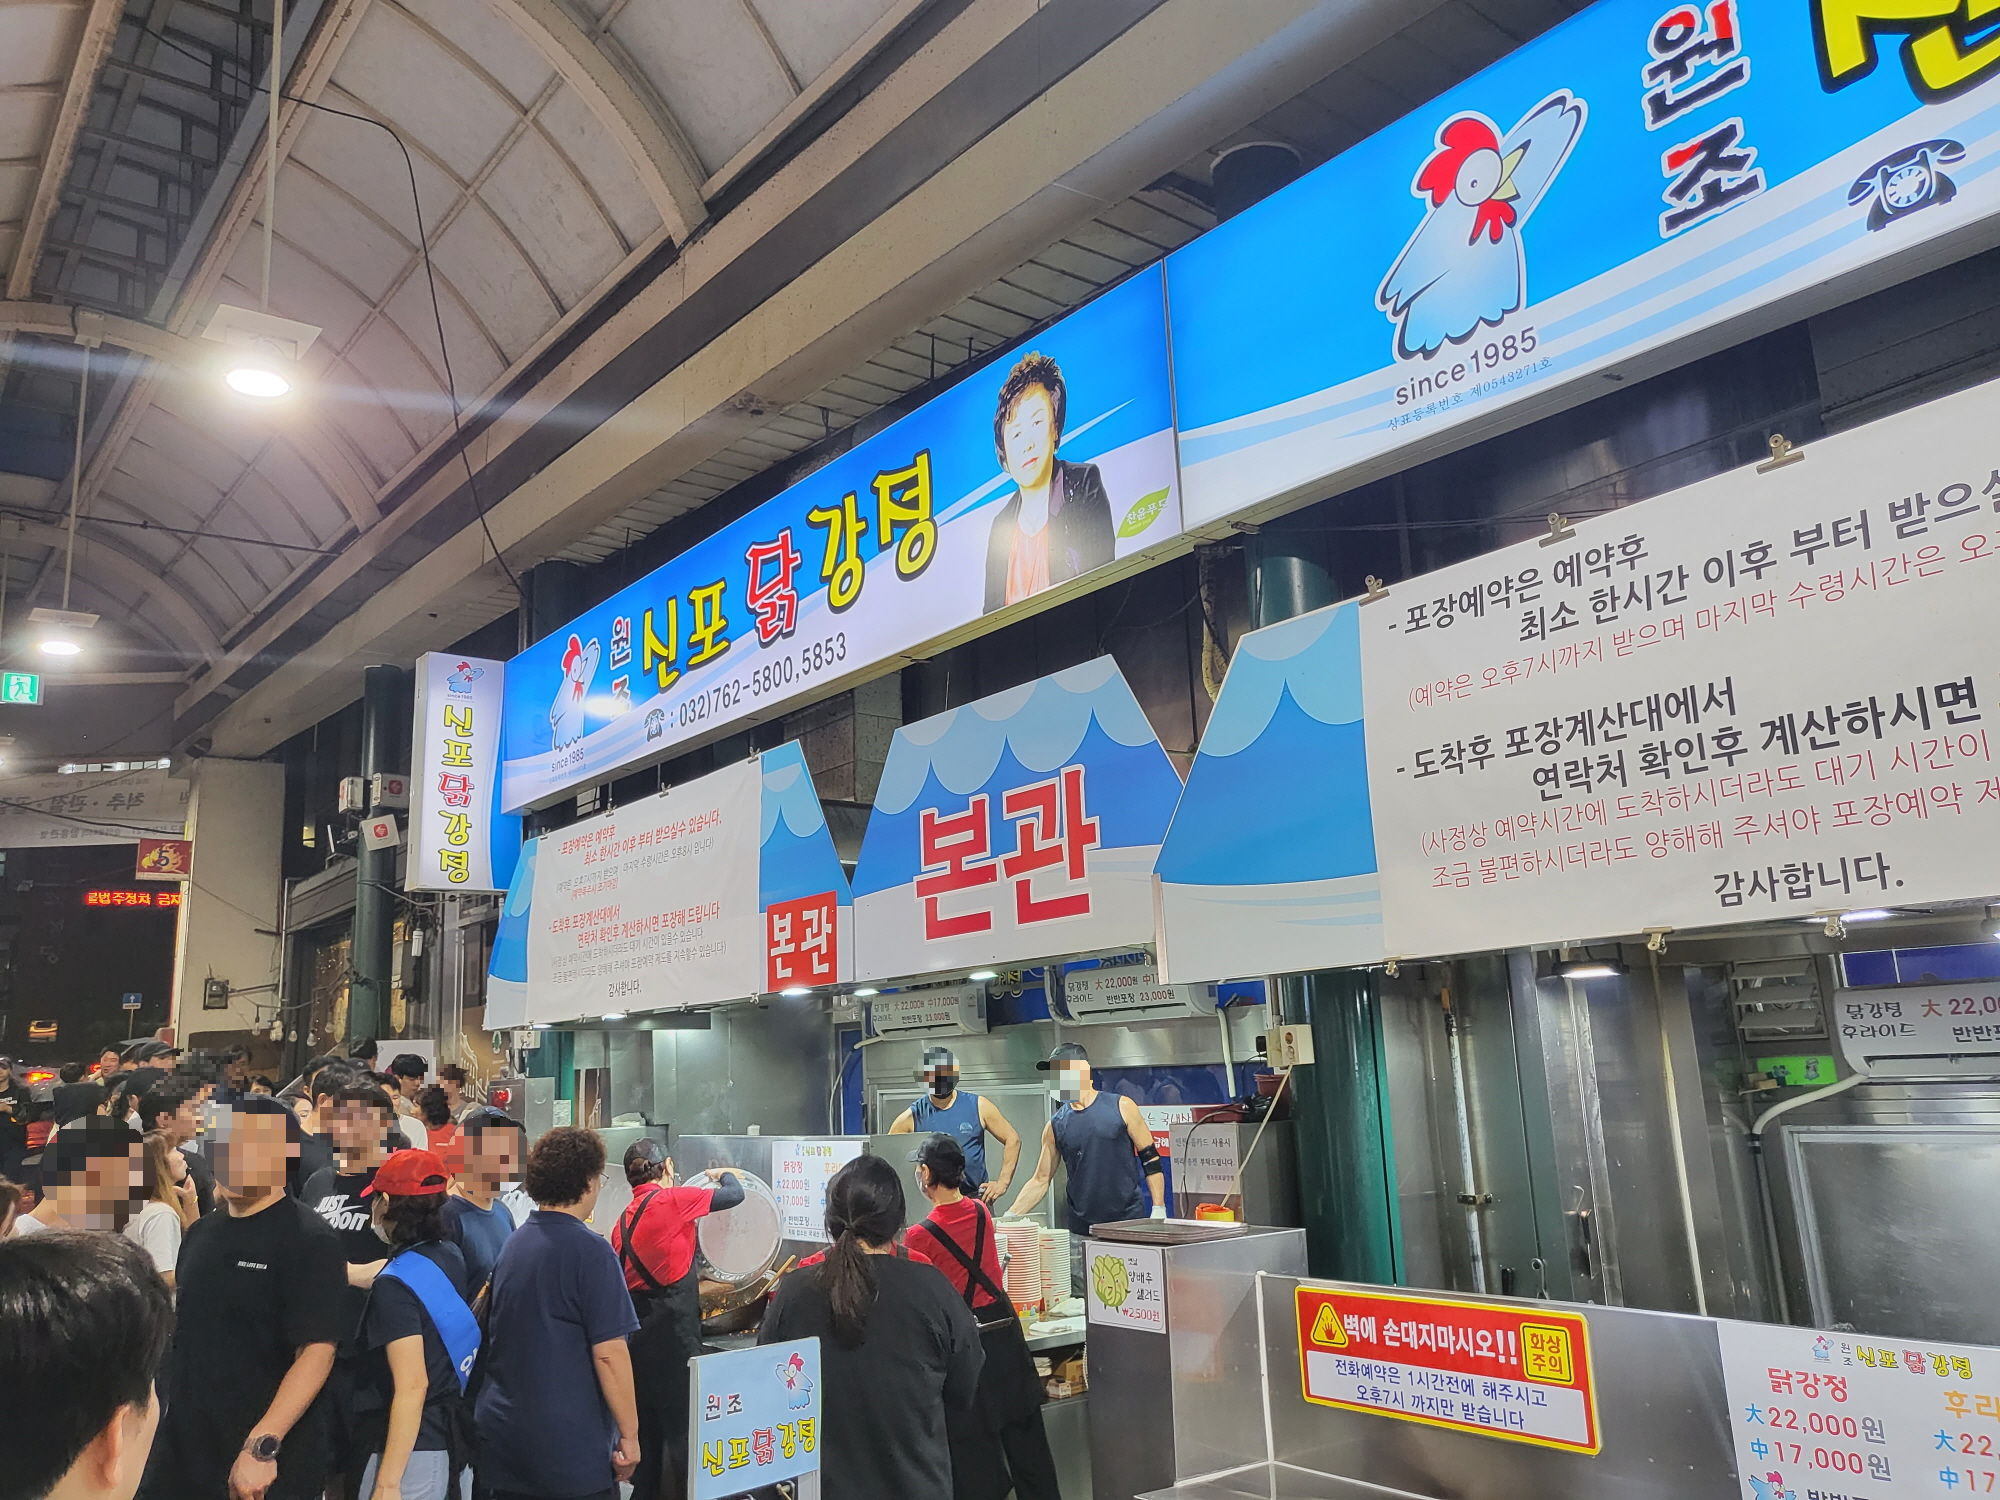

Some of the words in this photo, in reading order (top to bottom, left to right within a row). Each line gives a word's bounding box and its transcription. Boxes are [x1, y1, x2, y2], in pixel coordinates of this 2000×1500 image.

[1387, 392, 1464, 432] 상표등록번호
[1519, 601, 1580, 641] 최소
[1589, 564, 1690, 625] 한시간
[1703, 540, 1777, 588] 이후
[1790, 509, 1871, 566] 부터
[1553, 533, 1649, 588] 예약후
[1408, 673, 1473, 712] (예약은
[1480, 637, 1603, 690] 오후7시까지
[1613, 614, 1685, 657] 받으며
[1696, 590, 1778, 632] 마지막
[1787, 545, 1946, 610] 수령시간은
[1413, 734, 1495, 779] 도착후
[1504, 676, 1736, 759] 포장계산대에서
[1532, 750, 1628, 802] 연락처
[1639, 725, 1748, 780] 확인후
[1760, 676, 1982, 755] 계산하시면
[1421, 821, 1488, 857] (사정상
[1495, 799, 1607, 842] 예약시간에
[1616, 765, 1805, 820] 도착하시더라도
[1815, 750, 1876, 785] 대기
[1891, 729, 1991, 773] 시간이
[158, 849, 170, 867] 5
[584, 850, 597, 866] 최소
[600, 842, 620, 862] 한시간
[622, 836, 636, 855] 이후
[638, 829, 654, 849] 부터
[656, 820, 686, 844] 받으실수
[688, 808, 722, 836] 있습니다.
[595, 824, 616, 844] 예약후
[913, 764, 1102, 946] 본관
[1432, 861, 1471, 888] 조금
[1478, 835, 1638, 884] 불편하시더라도
[1645, 820, 1723, 858] 양해해
[1733, 805, 1822, 845] 주셔야
[1832, 782, 1964, 828] 포장예약
[1713, 851, 1904, 908] 감사합니다.
[572, 903, 621, 929] 포장계산대에서
[577, 930, 598, 949] 연락처
[599, 924, 619, 944] 확인후
[621, 914, 659, 938] 계산하시면
[661, 908, 686, 929] 포장해
[687, 901, 721, 924] 드립니다
[770, 905, 833, 979] 본관
[608, 979, 642, 998] 감사합니다.
[1139, 989, 1175, 1002] 23,000원
[1920, 998, 1943, 1018] 大
[1840, 1022, 1917, 1040] 후라이드
[313, 1195, 350, 1213] JUST
[1128, 1270, 1153, 1285] 양배추
[1343, 1313, 1377, 1344] 벽에
[1382, 1318, 1518, 1365] 손대지마시오!!
[1530, 1332, 1562, 1354] 화상
[1335, 1358, 1400, 1383] 전화예약은
[1408, 1370, 1475, 1397] 1시간전에
[1482, 1381, 1548, 1407] 해주시고
[1532, 1353, 1564, 1375] 주의
[1767, 1367, 1848, 1403] 닭강정
[704, 1392, 744, 1424] 원조
[1356, 1385, 1405, 1409] 오후7시
[1411, 1394, 1454, 1417] 까지만
[1461, 1402, 1525, 1430] 받습니다
[1744, 1403, 1765, 1425] 大
[1933, 1429, 1957, 1453] 大
[1750, 1437, 1769, 1460] 中
[1939, 1466, 1959, 1490] 中
